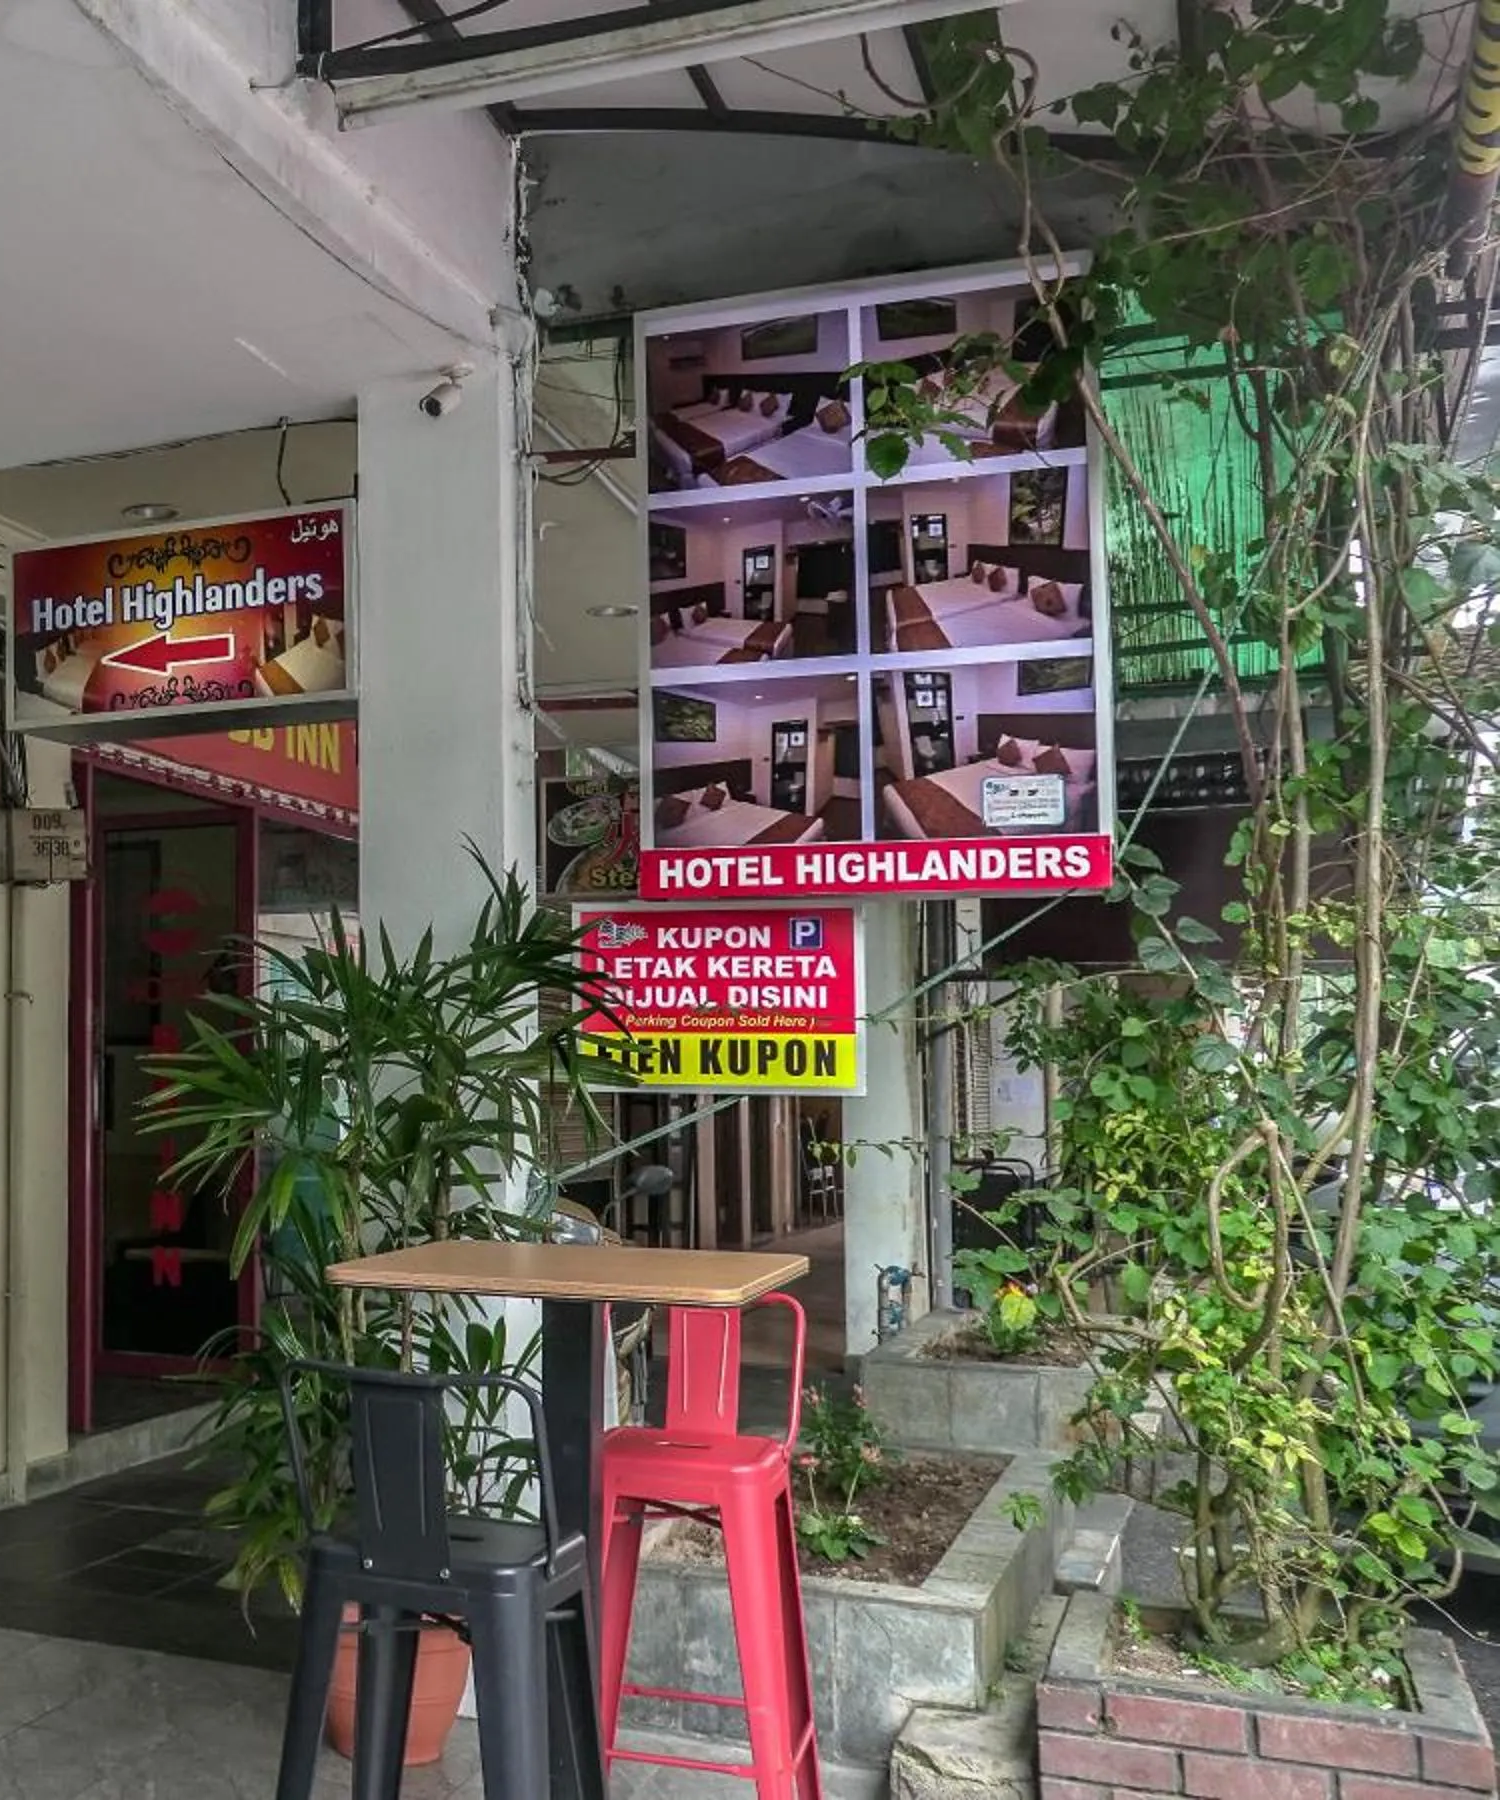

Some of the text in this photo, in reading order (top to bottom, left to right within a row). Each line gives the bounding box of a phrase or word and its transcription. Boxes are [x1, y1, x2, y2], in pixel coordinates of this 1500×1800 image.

[31, 566, 325, 634] Hotel Highlanders
[285, 722, 341, 774] INN
[659, 845, 1091, 889] HOTEL HIGHLANDERS
[657, 927, 771, 949] KUPON
[708, 955, 837, 978] KERETA
[728, 985, 828, 1009] DISINI
[681, 1014, 734, 1029] Coupon
[739, 1013, 769, 1027] Sold
[700, 1039, 837, 1077] KUPON
